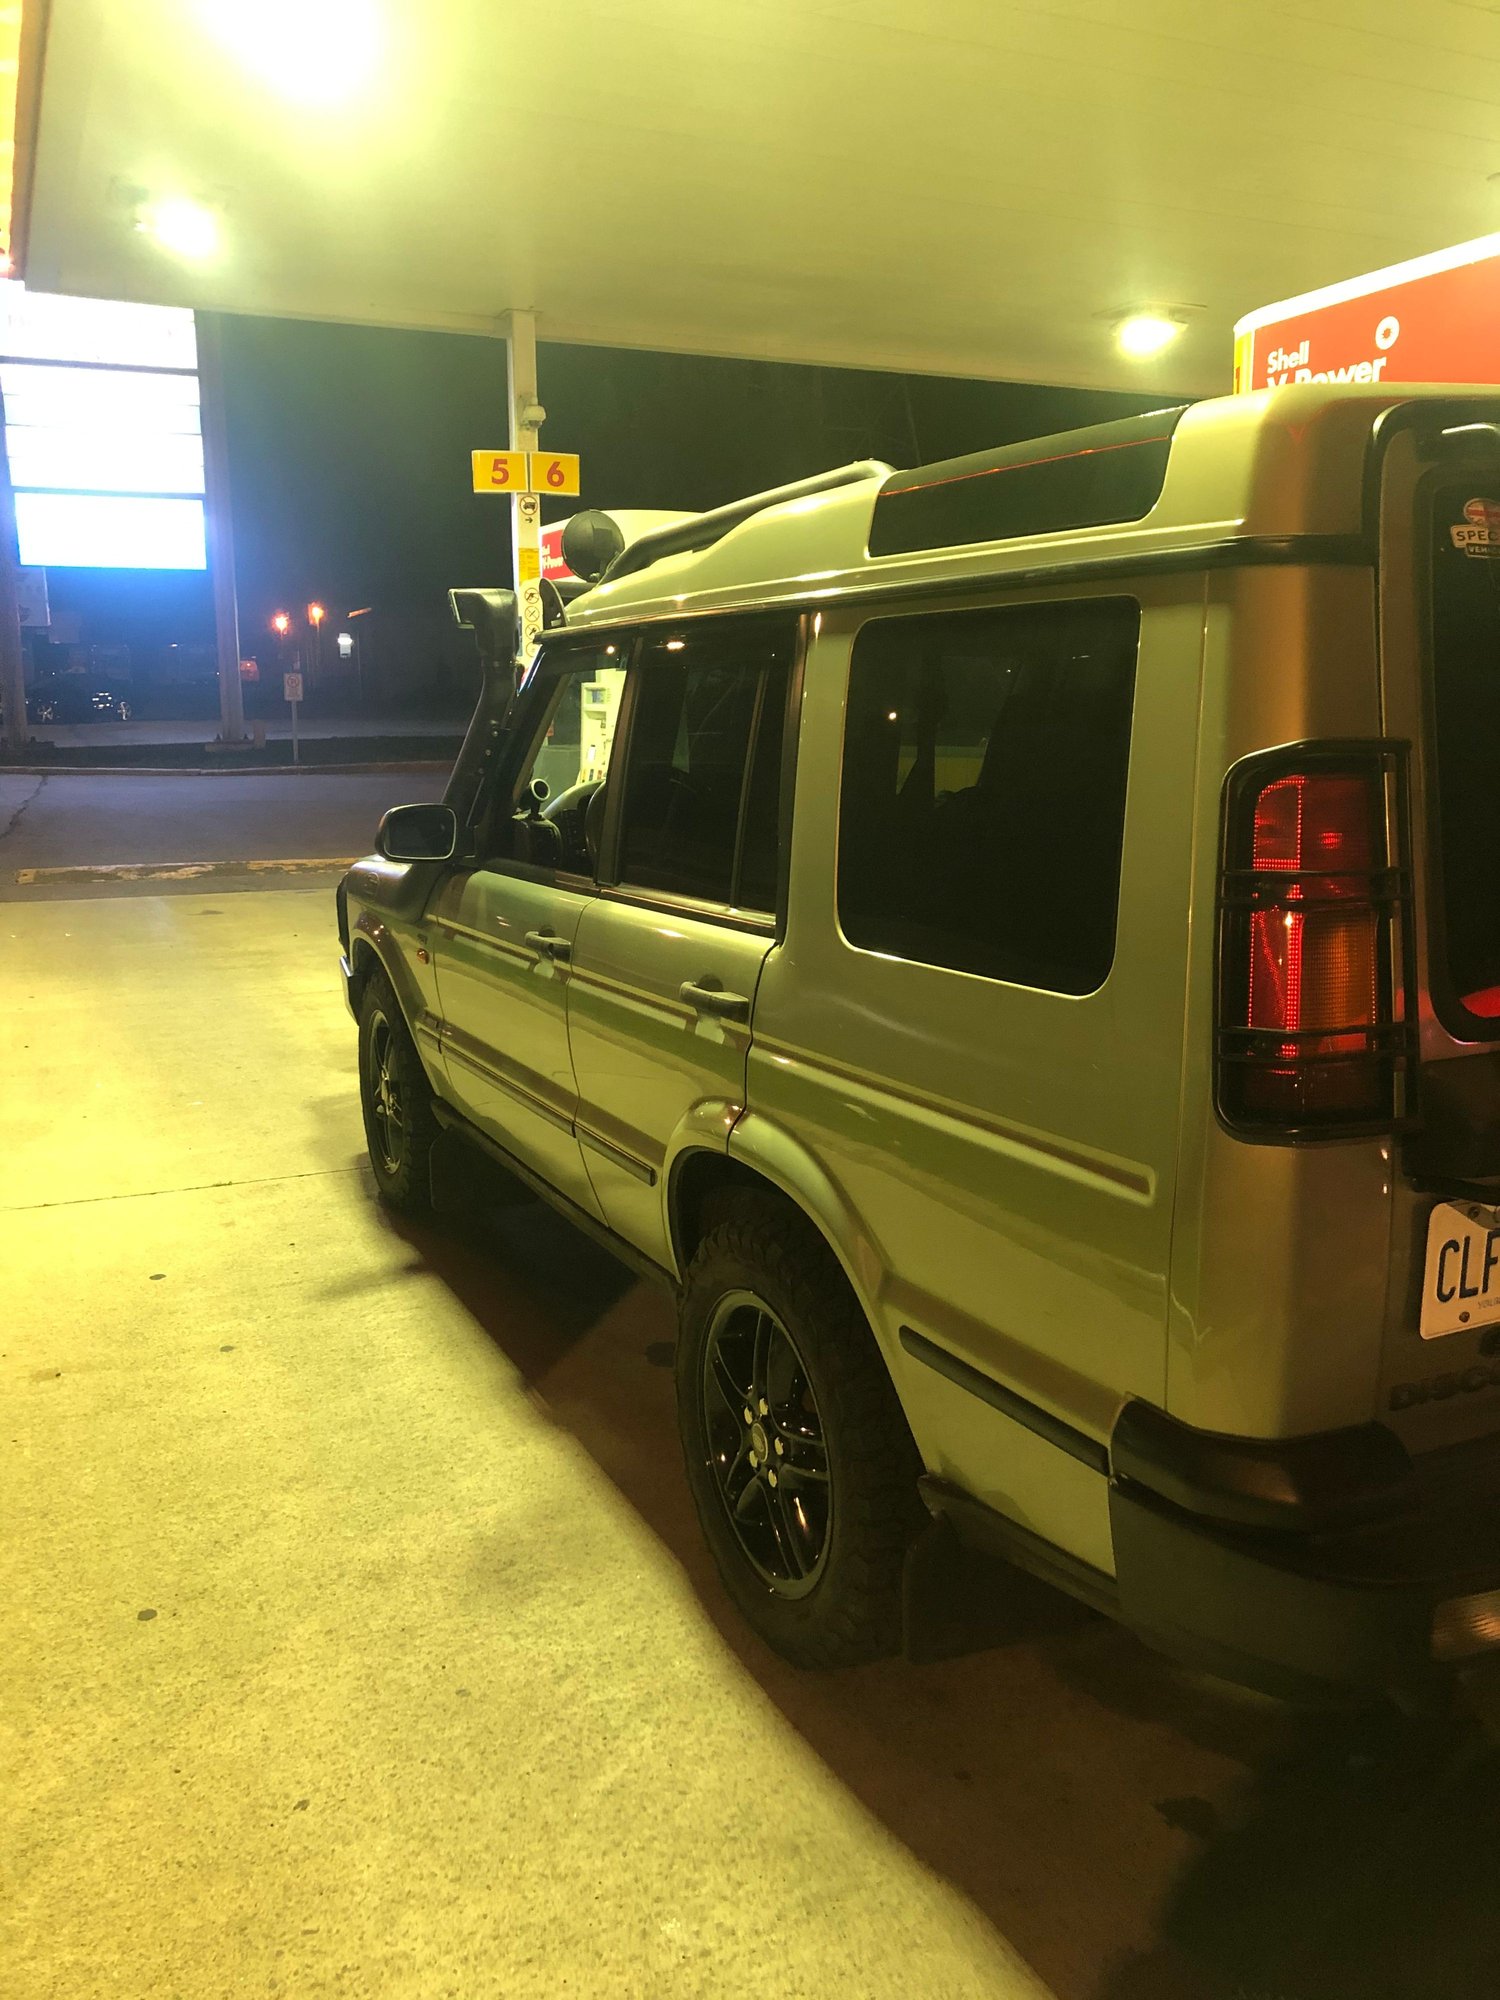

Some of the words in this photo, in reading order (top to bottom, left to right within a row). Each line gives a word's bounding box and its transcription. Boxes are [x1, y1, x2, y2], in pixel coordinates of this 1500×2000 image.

[1267, 340, 1310, 374] Shell
[491, 458, 510, 485] 5
[546, 461, 565, 487] 6
[1436, 1227, 1500, 1303] CLF
